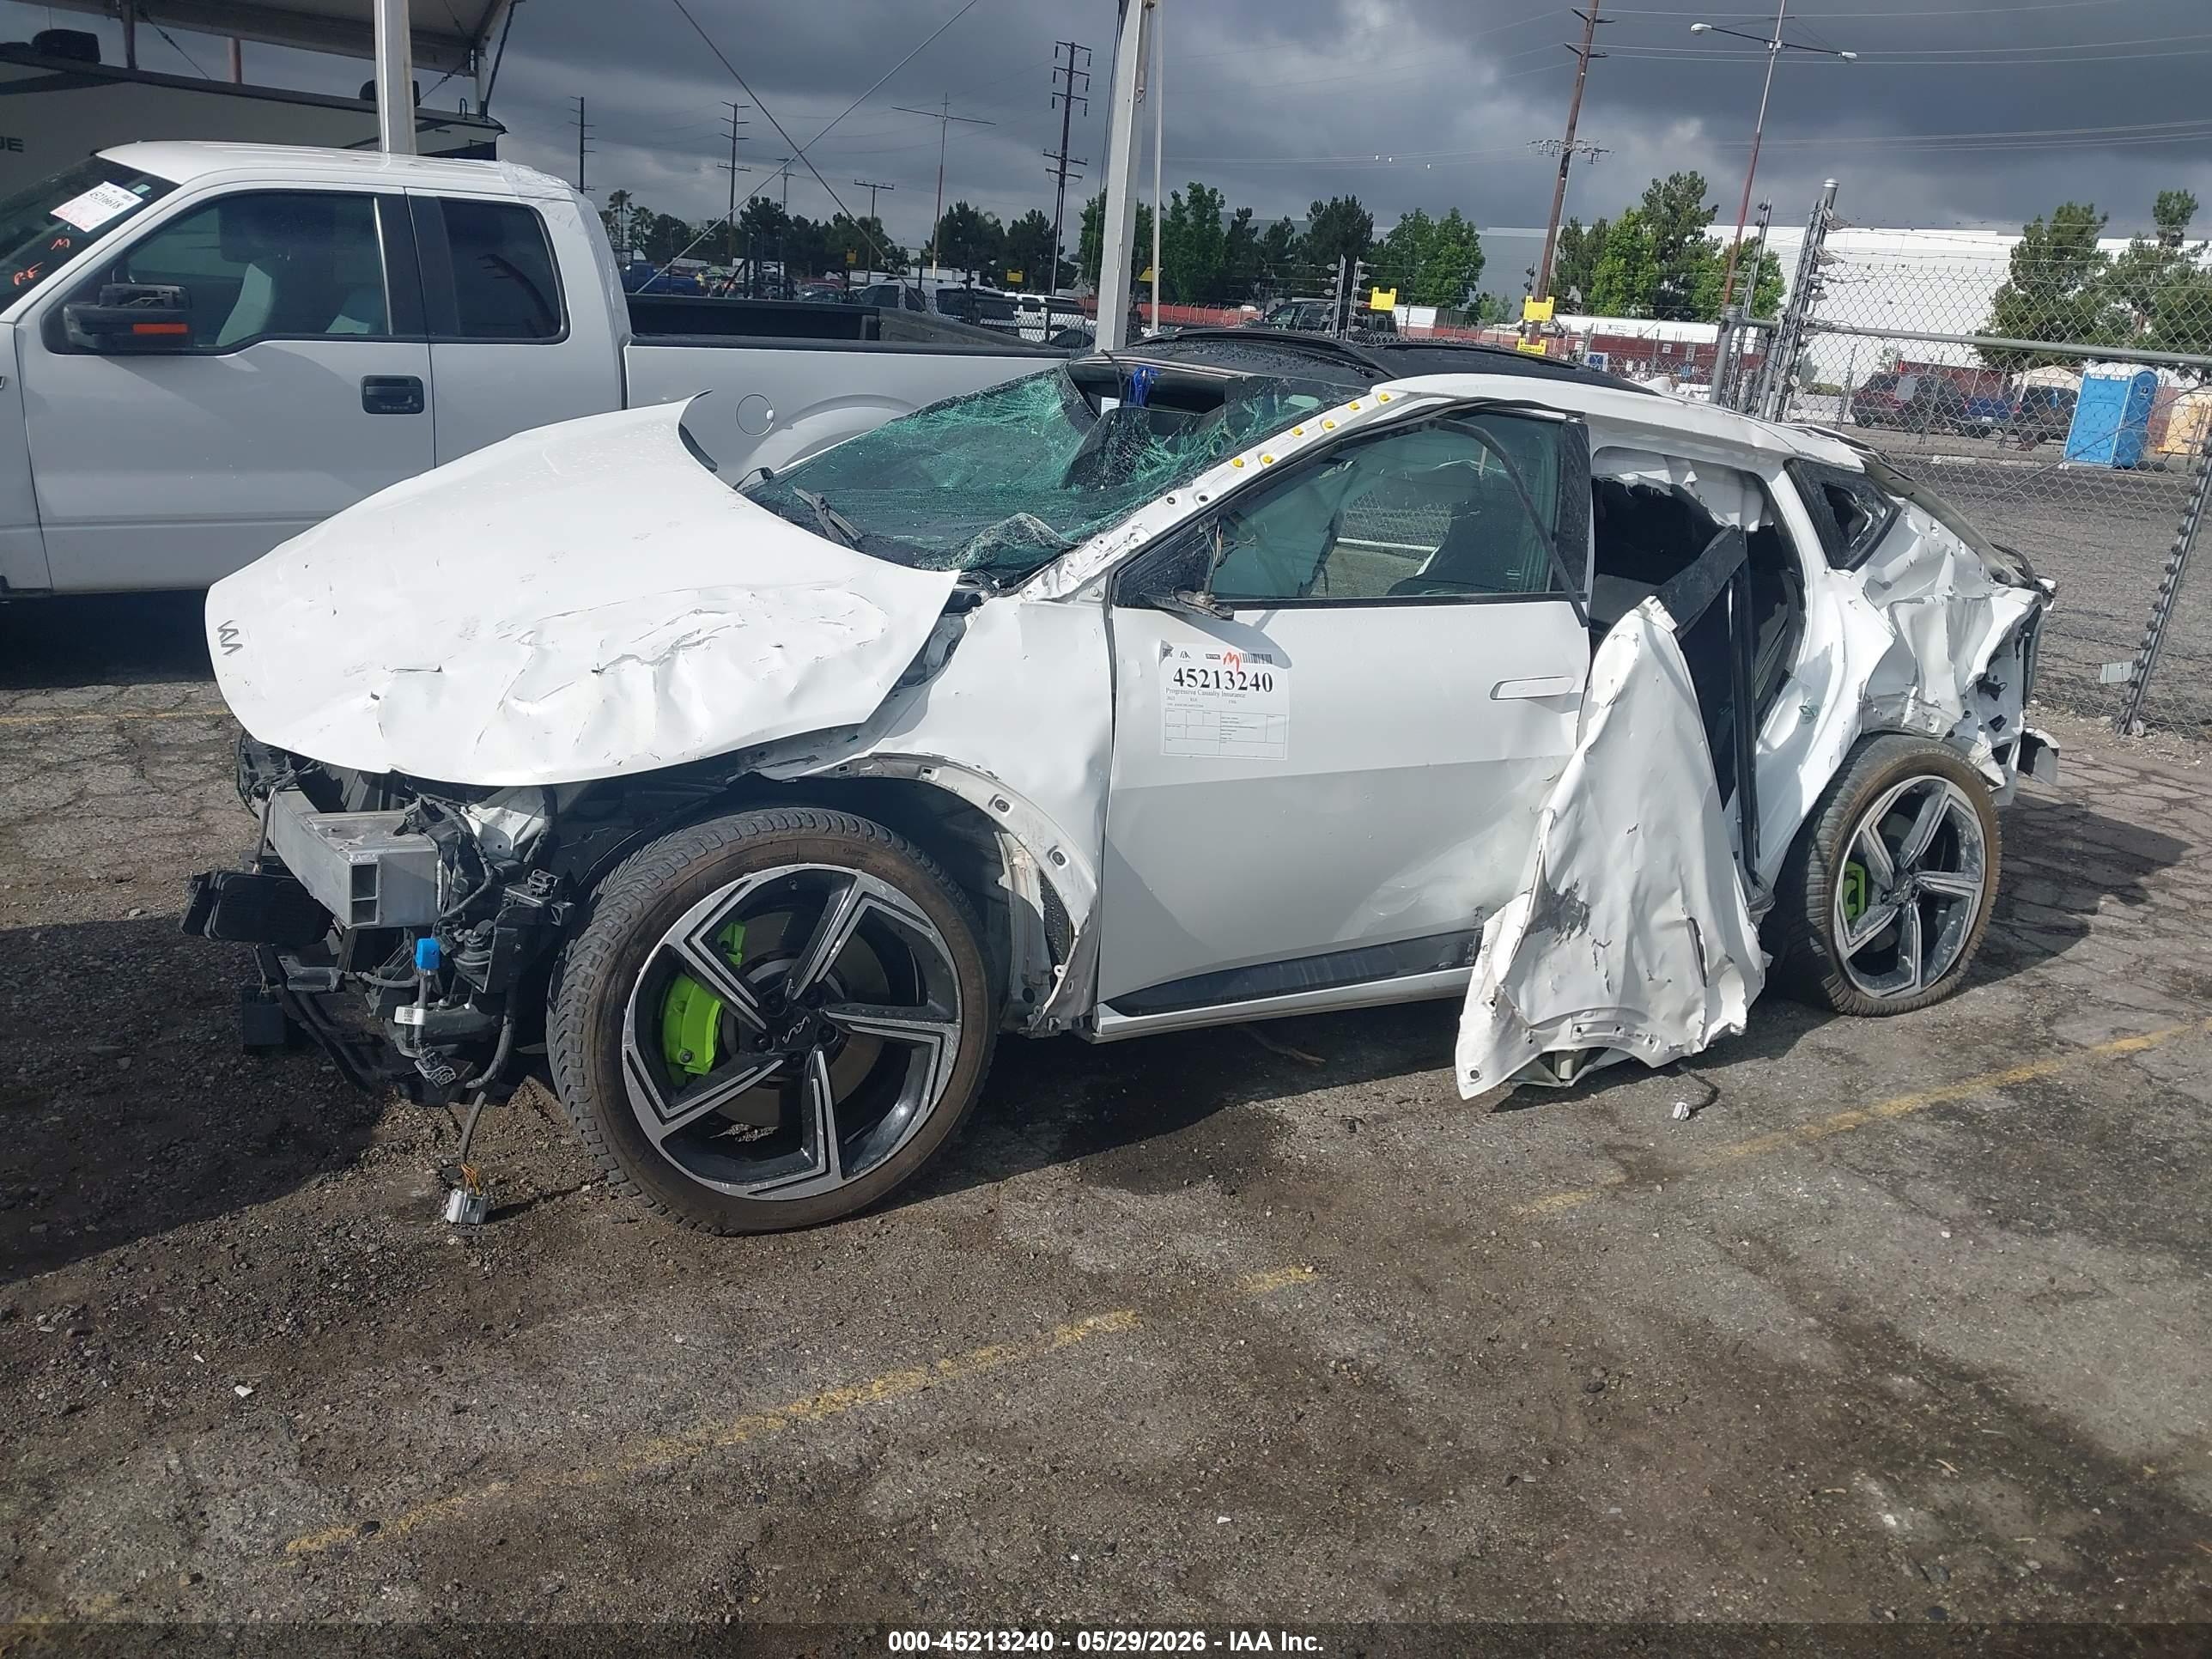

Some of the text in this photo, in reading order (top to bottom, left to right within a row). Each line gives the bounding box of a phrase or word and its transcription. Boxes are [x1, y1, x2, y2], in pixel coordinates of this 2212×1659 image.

[89, 191, 125, 210] 45216618
[1173, 666, 1273, 693] 45213240
[1165, 687, 1196, 697] Progressive
[1197, 690, 1220, 698] Casualty
